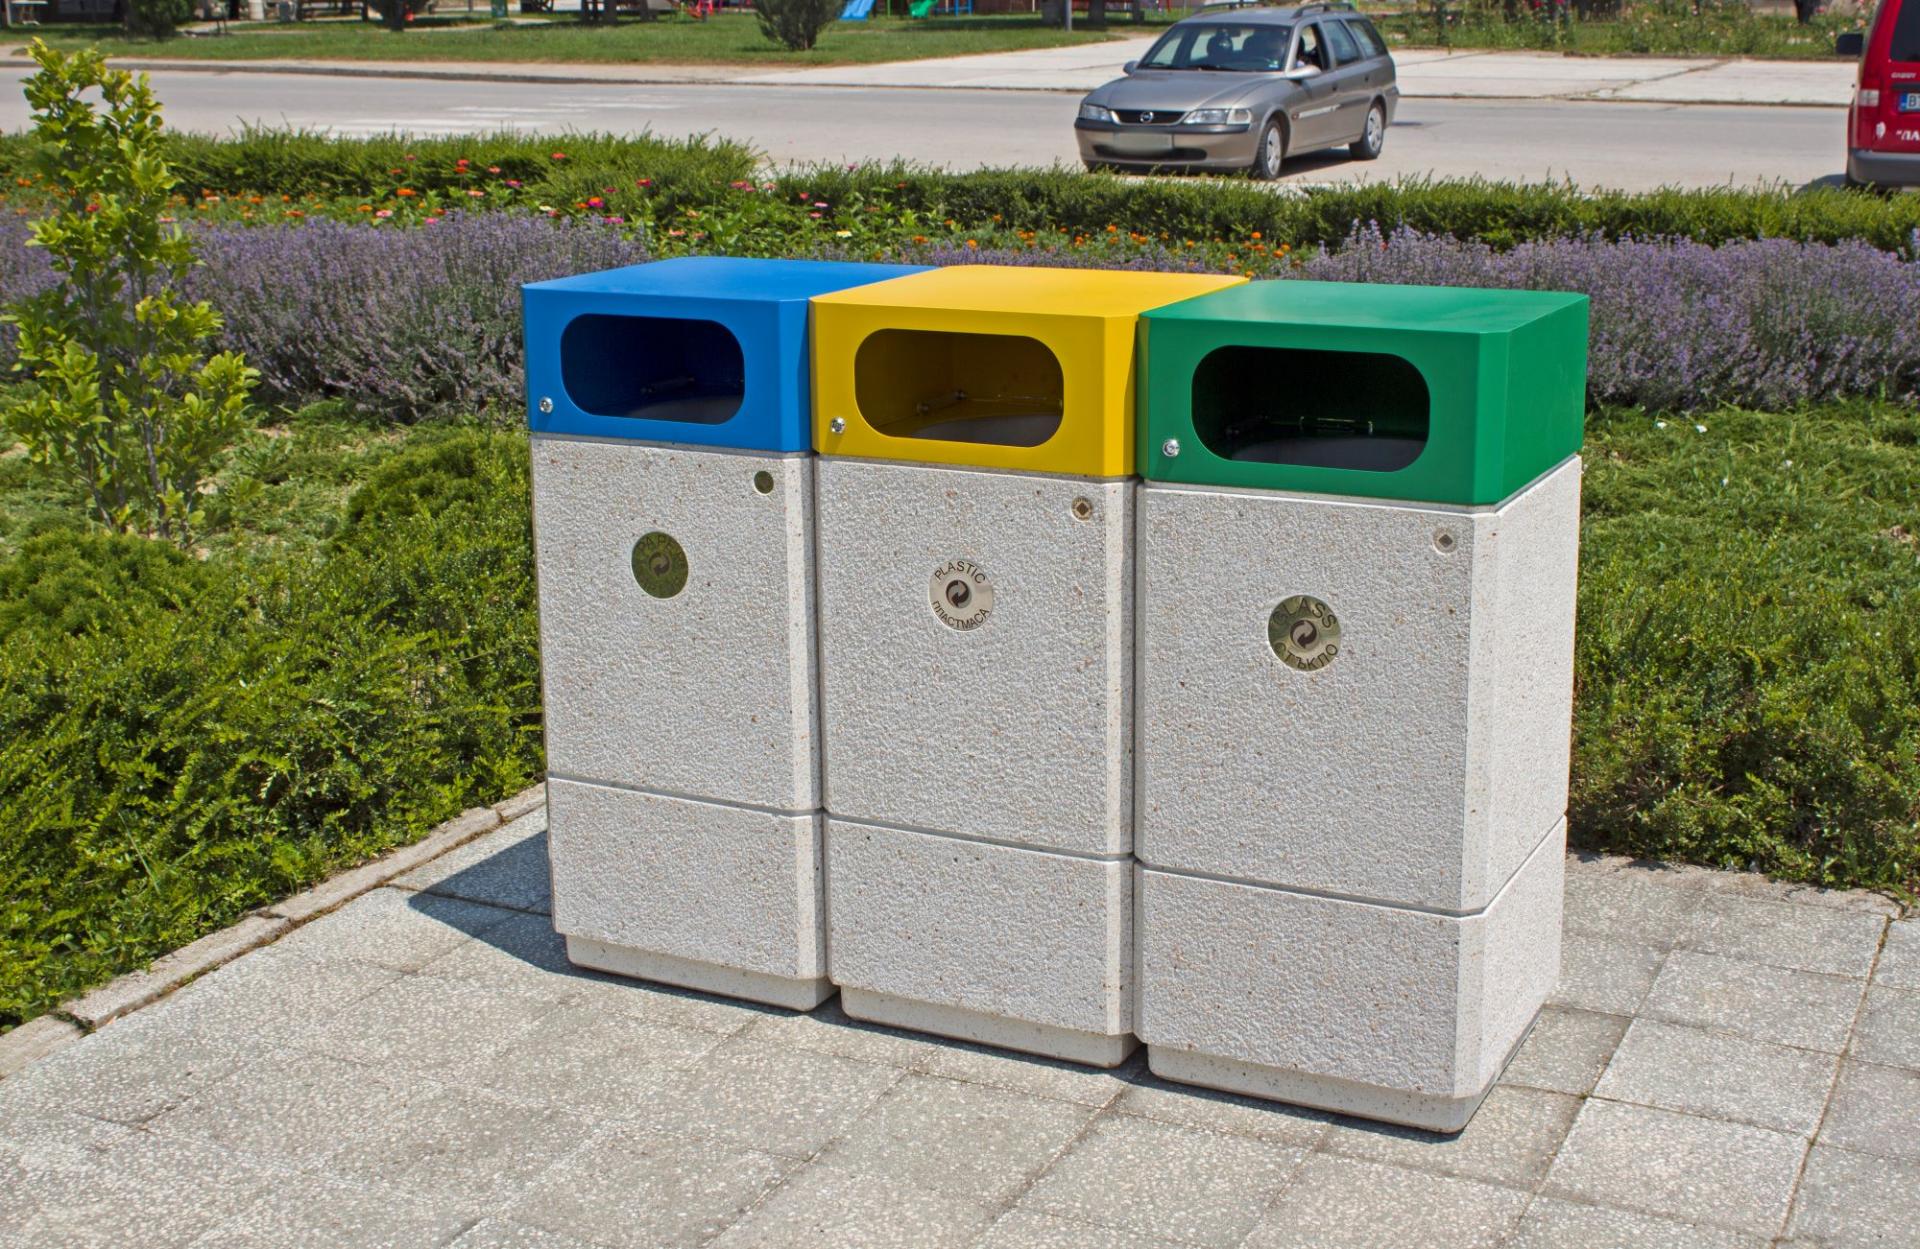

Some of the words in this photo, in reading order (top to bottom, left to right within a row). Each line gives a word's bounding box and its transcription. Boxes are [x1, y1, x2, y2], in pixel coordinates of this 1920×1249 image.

[934, 560, 986, 584] PLASTIC
[932, 600, 990, 629] ПЛАСТМАСА
[1272, 597, 1338, 629] GLASS
[1275, 642, 1338, 671] СТЪКЛО
